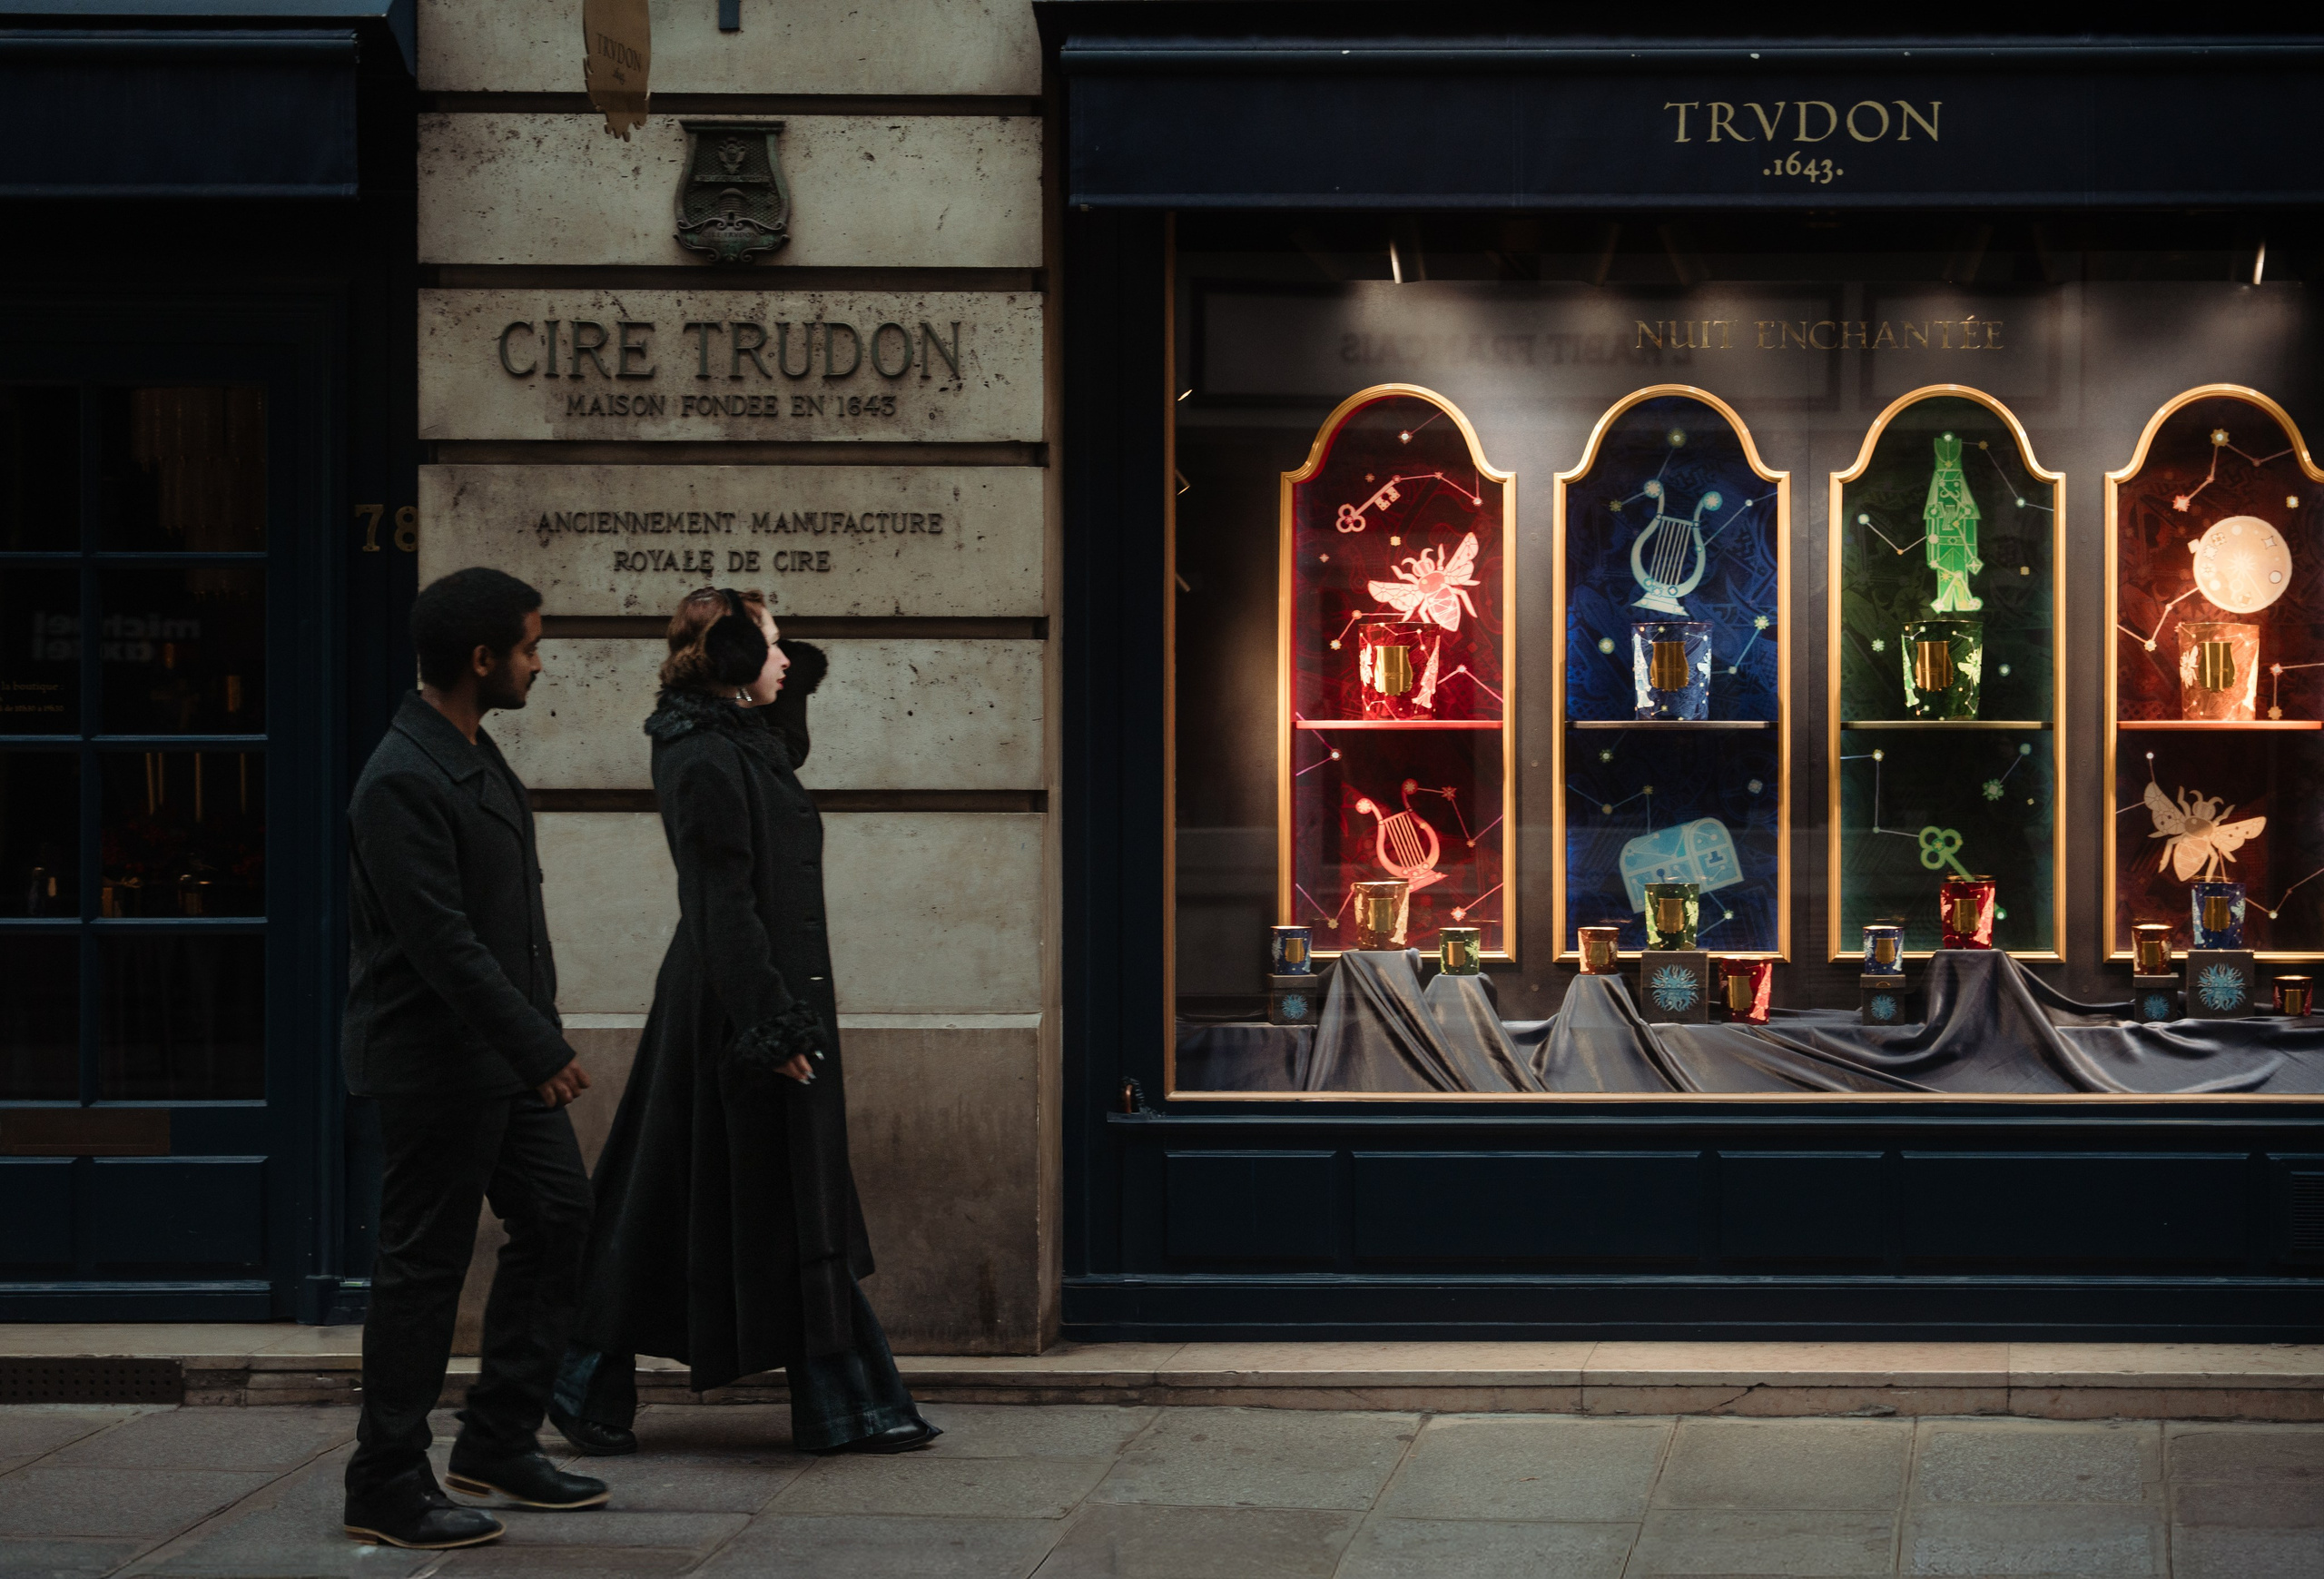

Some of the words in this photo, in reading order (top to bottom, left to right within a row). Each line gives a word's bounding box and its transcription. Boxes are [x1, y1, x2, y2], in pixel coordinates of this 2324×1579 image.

[596, 33, 642, 72] TRVDON
[1663, 100, 1944, 143] TRVDON
[1635, 320, 1738, 350] NUIT
[1754, 315, 2004, 350] ENCHANTÉE
[500, 321, 655, 380] CIRE
[684, 321, 960, 380] TRUDON
[566, 396, 665, 416] MAISON
[681, 396, 778, 417] FONDEE
[791, 396, 824, 417] EN
[838, 396, 896, 417] 1643
[355, 504, 418, 552] 78
[537, 512, 735, 534] ANCIENNEMENT
[752, 512, 943, 534] MANUFACTURE
[614, 550, 714, 572] ROYALE
[727, 550, 760, 572] DE
[774, 550, 831, 572] CIRE
[13, 679, 59, 695] boutique
